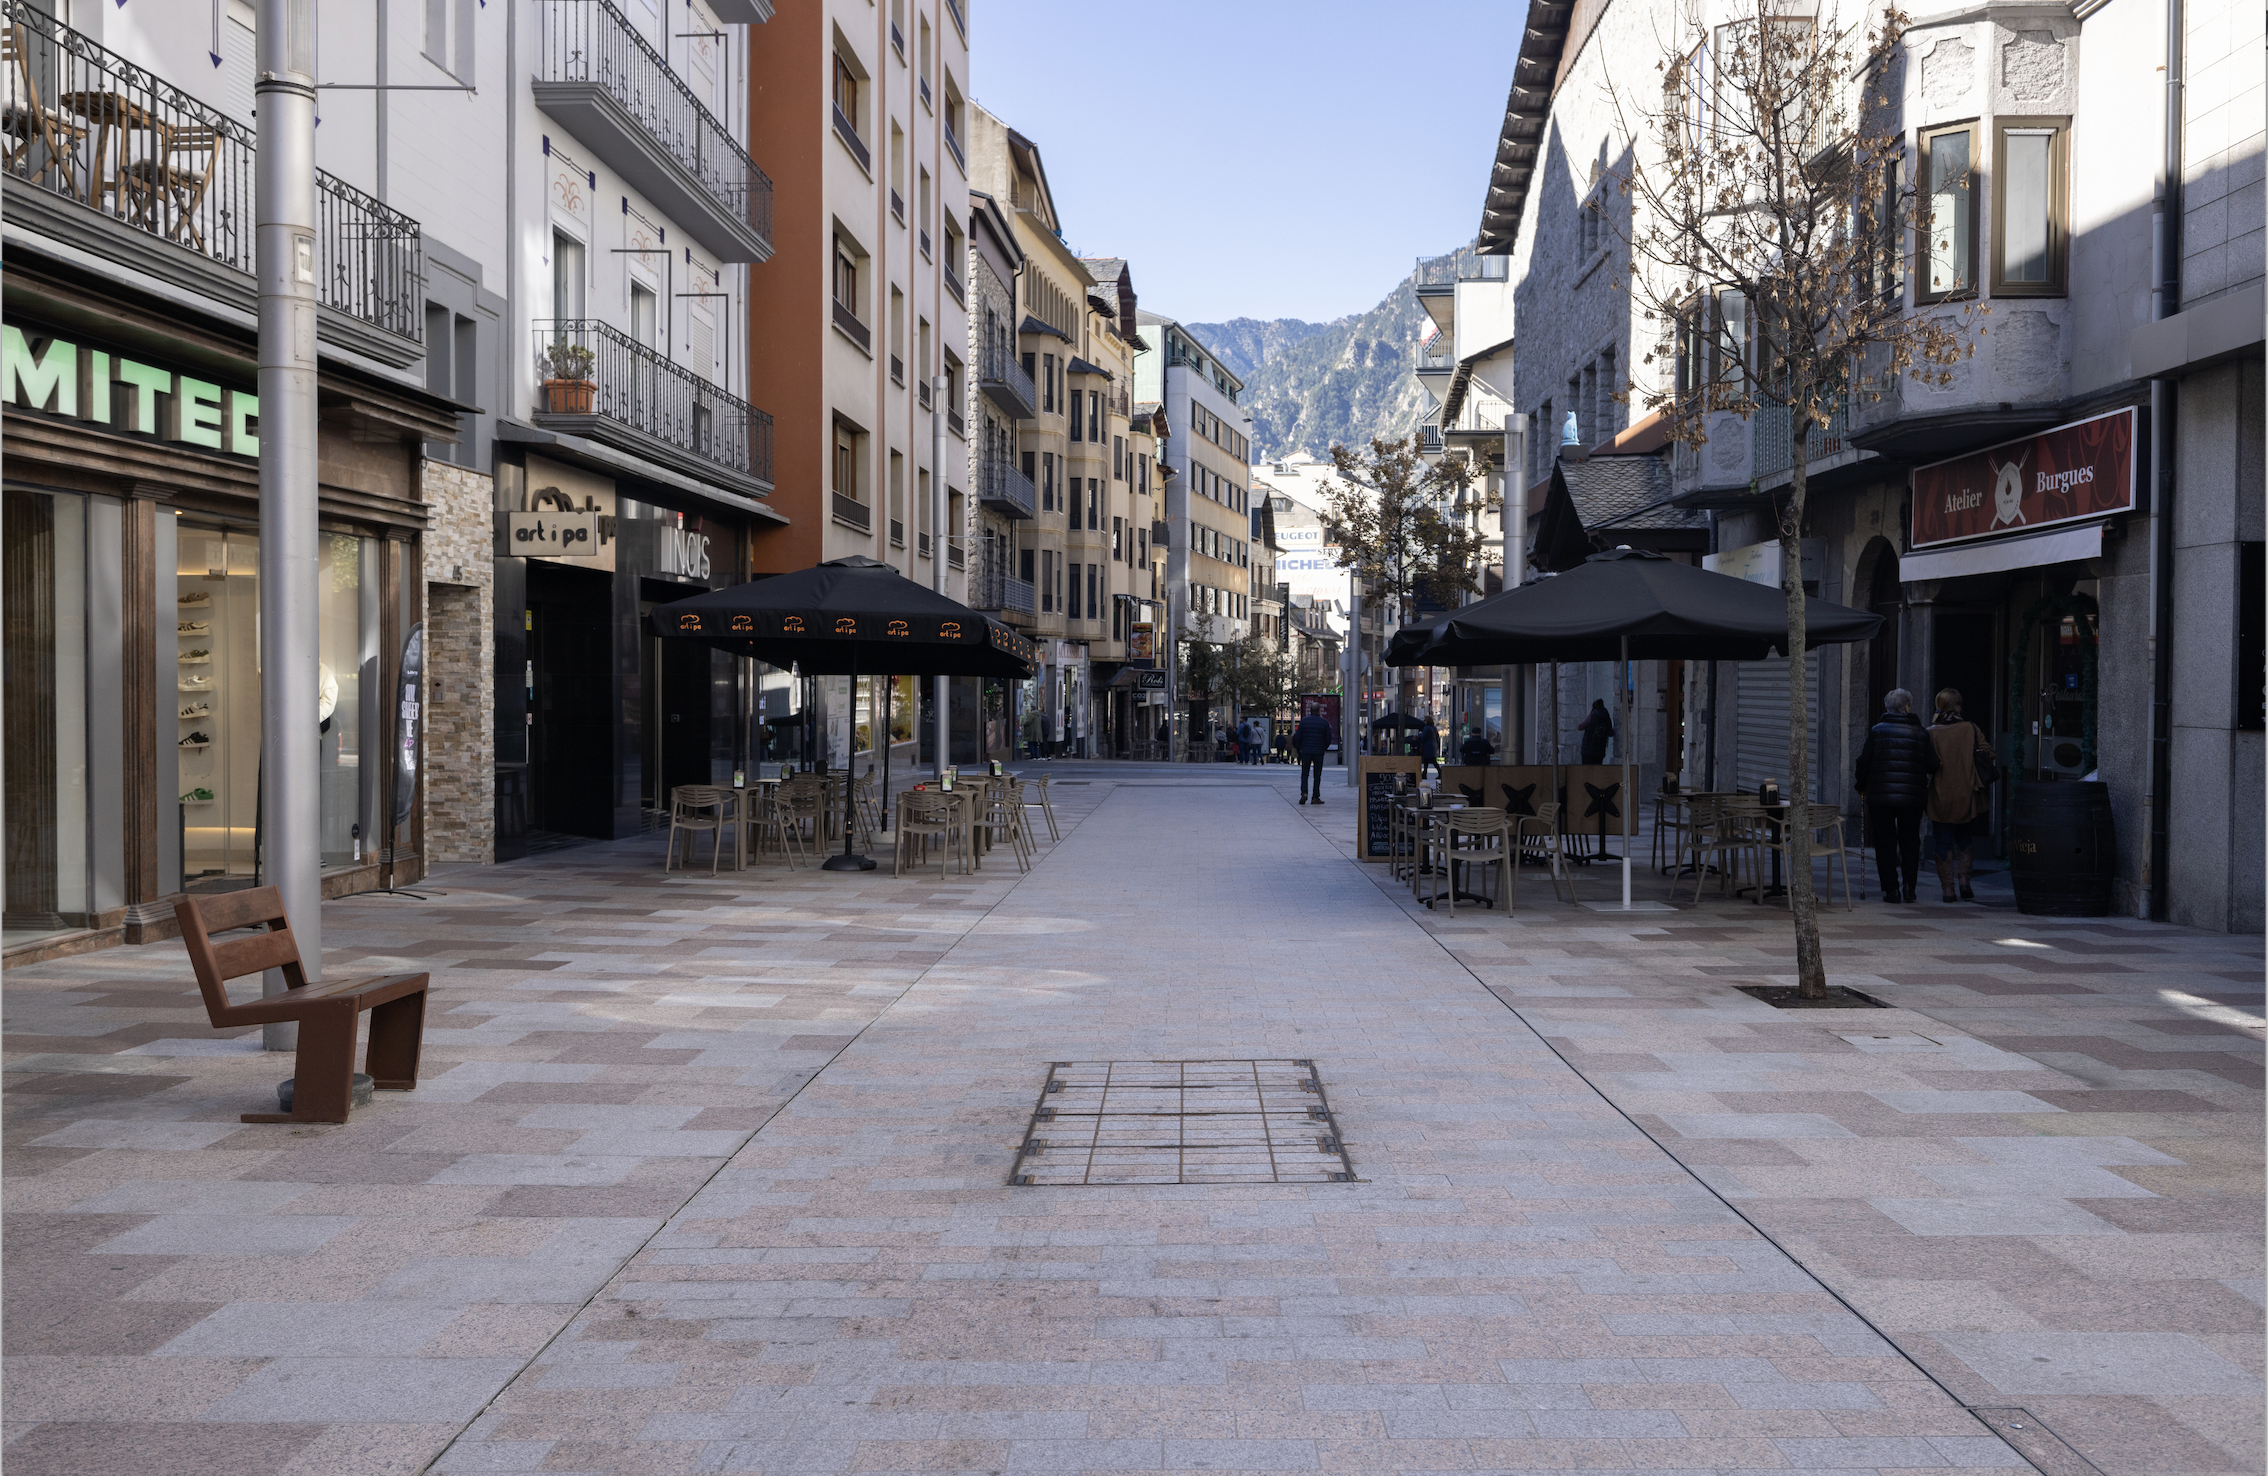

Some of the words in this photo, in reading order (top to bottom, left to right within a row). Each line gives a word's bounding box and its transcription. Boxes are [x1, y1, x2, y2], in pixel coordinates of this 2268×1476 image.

[1944, 488, 1982, 514] Atelier
[2036, 465, 2094, 494] Burgues
[1275, 531, 1318, 541] EUGEOT
[1275, 559, 1338, 570] ICHEL
